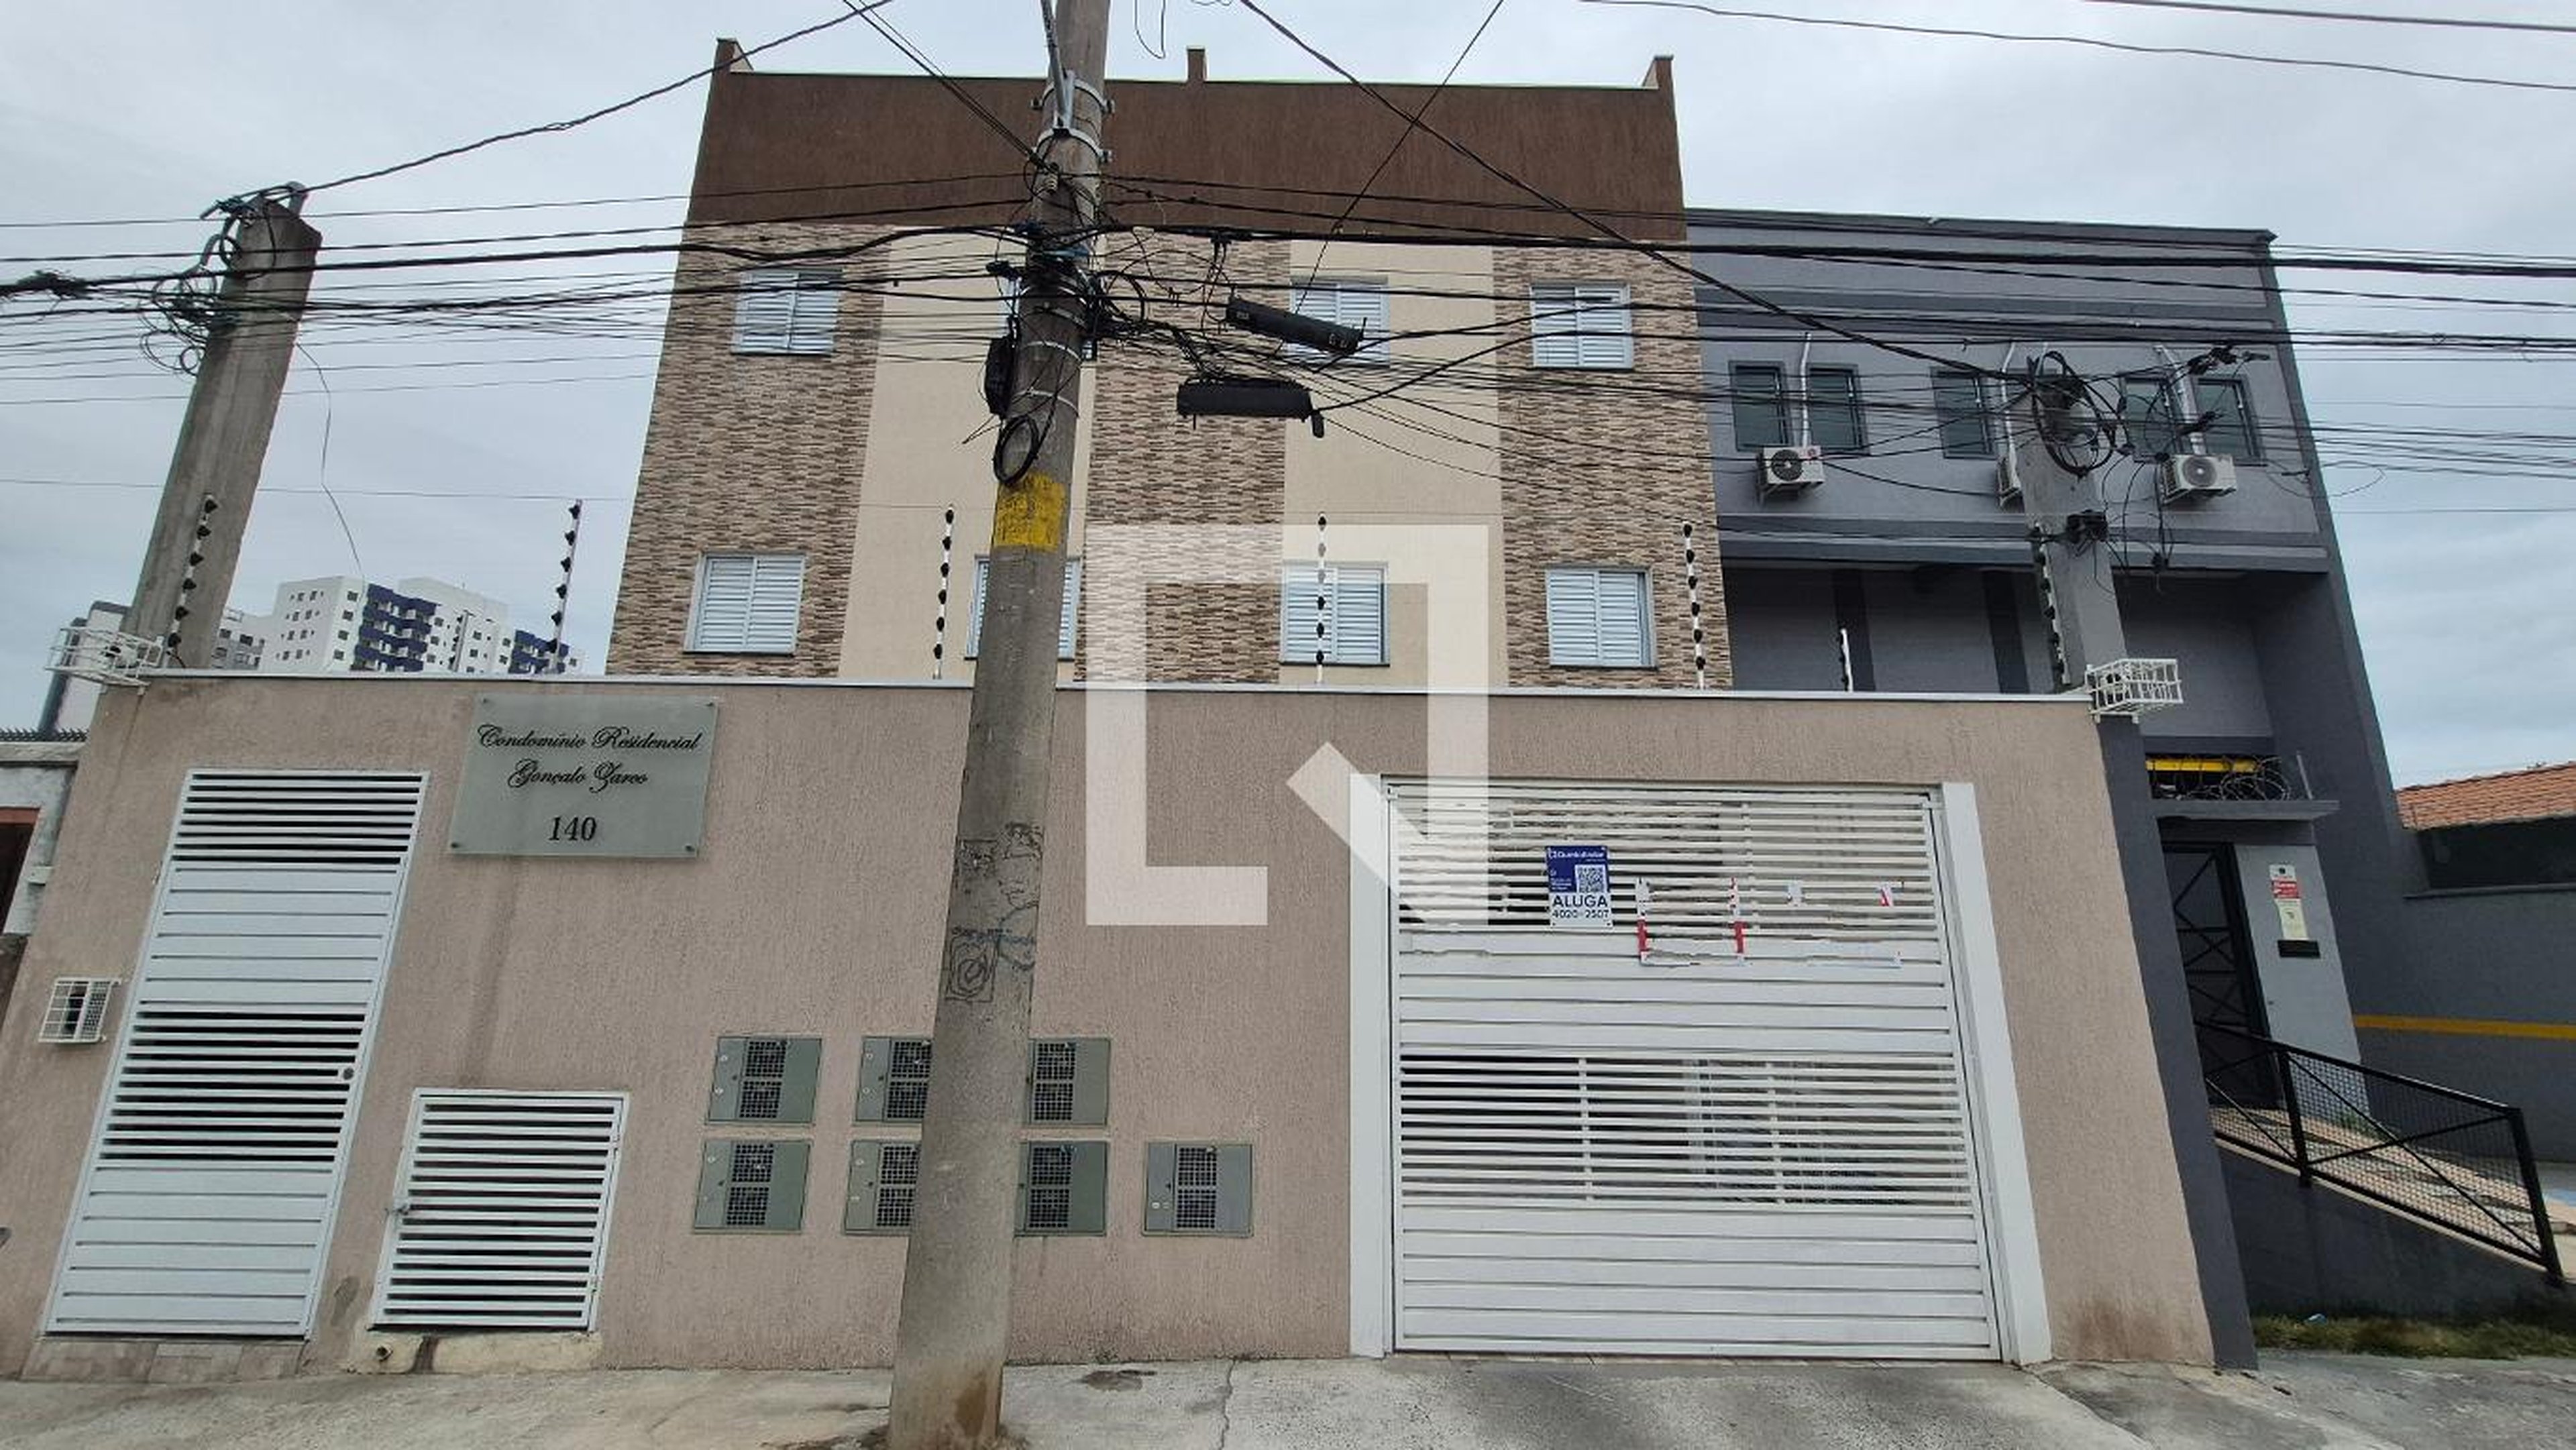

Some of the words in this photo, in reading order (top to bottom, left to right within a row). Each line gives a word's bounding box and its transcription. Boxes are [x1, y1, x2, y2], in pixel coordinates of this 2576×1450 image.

[592, 726, 703, 749] Residencial
[507, 759, 586, 788] Gonçalo
[549, 817, 596, 841] 140
[1552, 895, 1608, 907] ALUGA
